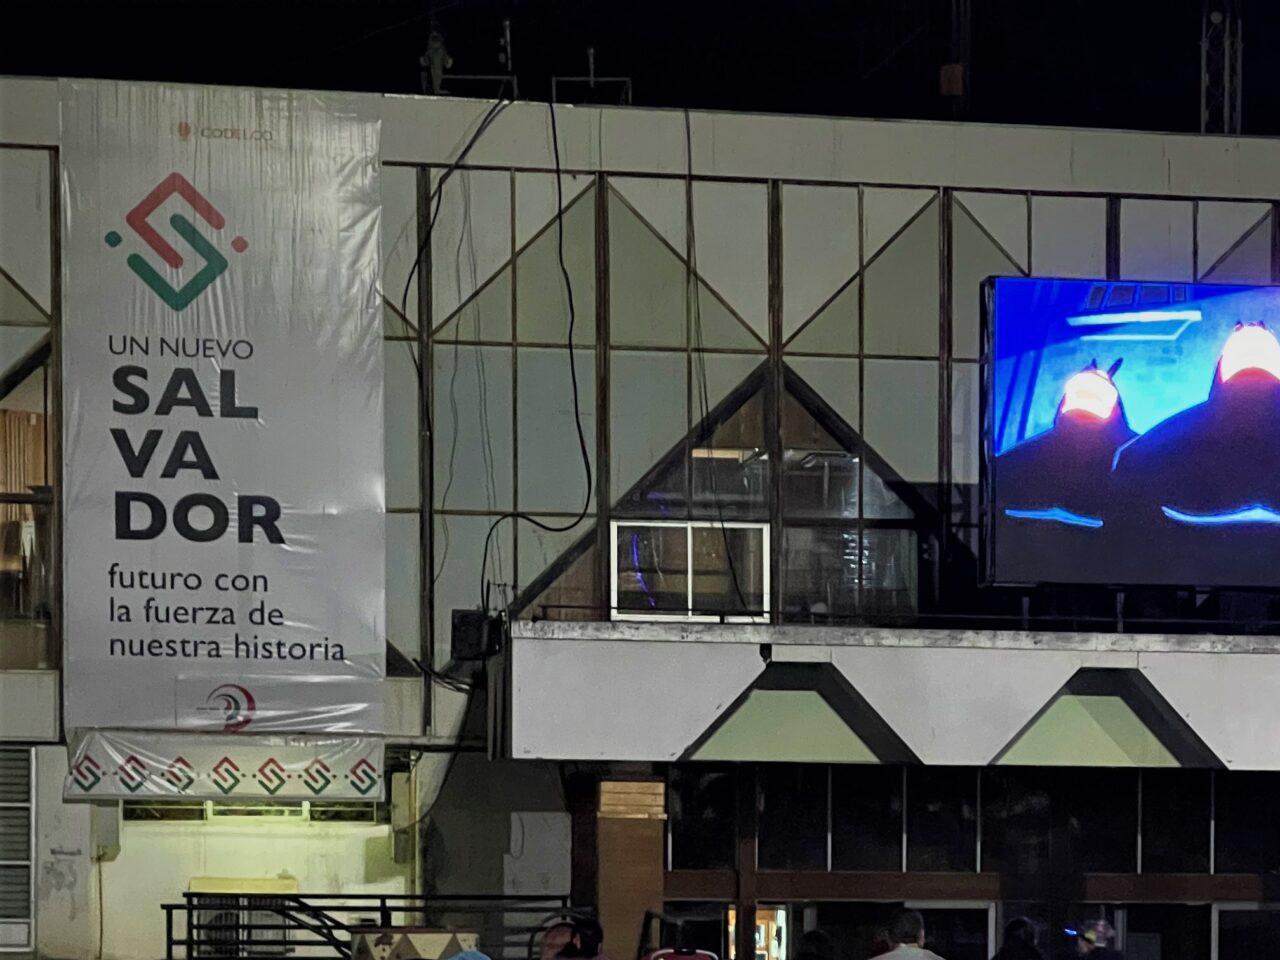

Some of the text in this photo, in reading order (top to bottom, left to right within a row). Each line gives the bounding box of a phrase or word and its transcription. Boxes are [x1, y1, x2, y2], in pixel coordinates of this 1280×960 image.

[108, 335, 254, 360] UN NUEVO
[112, 364, 259, 419] SAL
[109, 428, 220, 480] VA
[114, 490, 287, 545] DOR
[108, 562, 269, 593] futuro con
[109, 597, 285, 627] la fuerza de
[109, 633, 346, 662] nuestra historia
